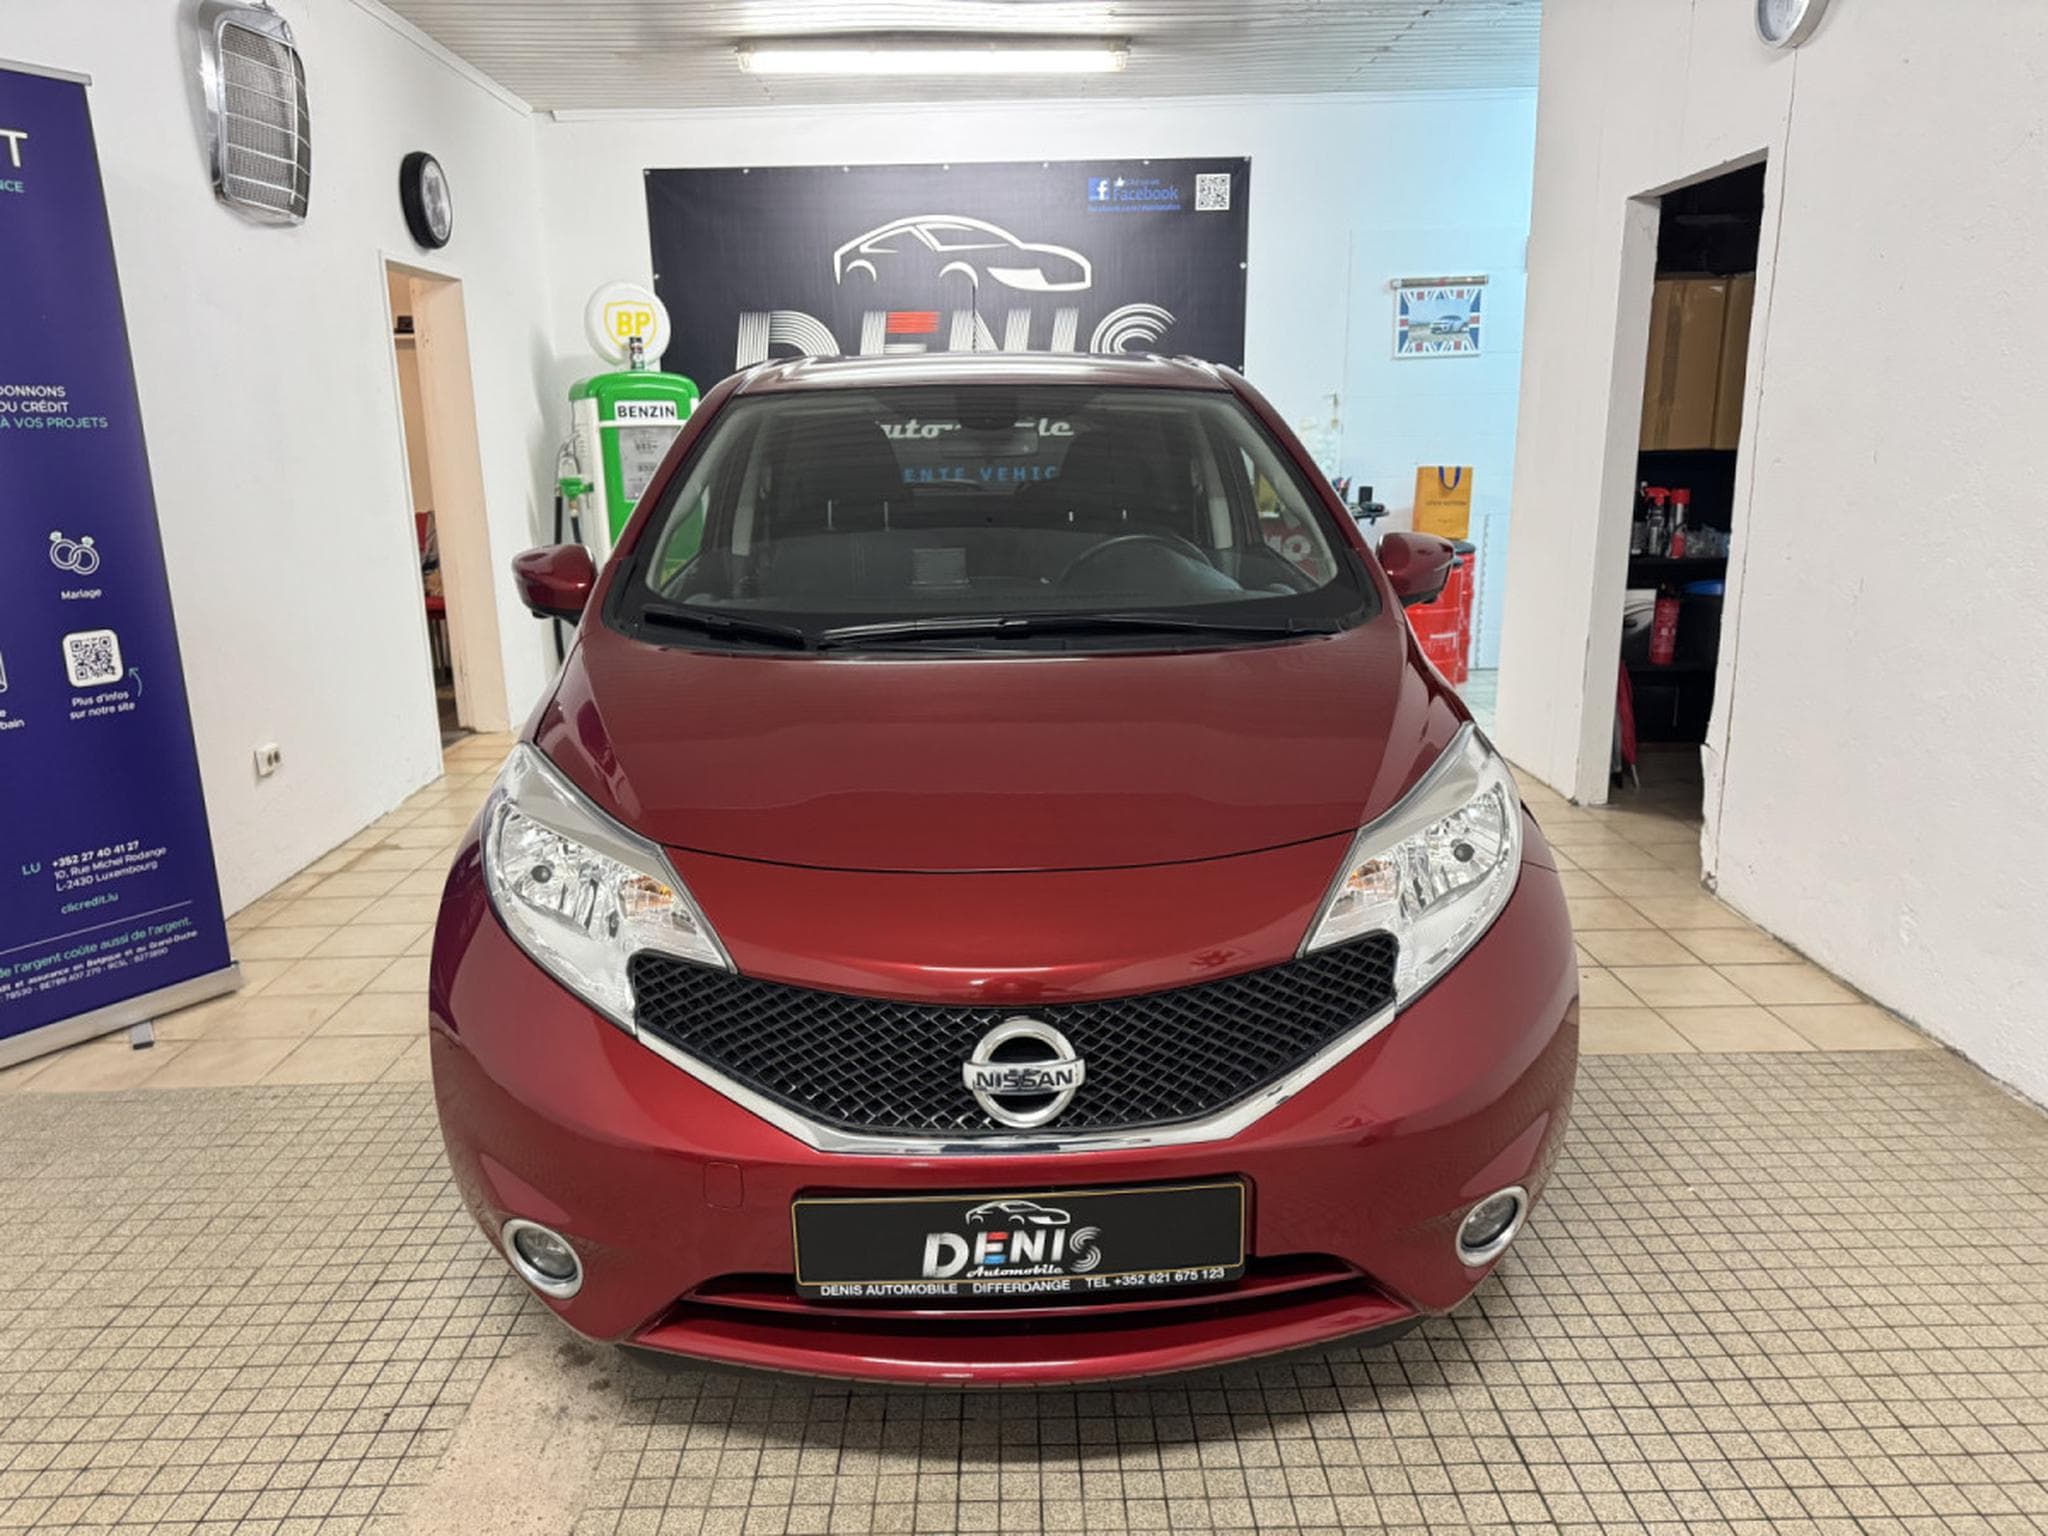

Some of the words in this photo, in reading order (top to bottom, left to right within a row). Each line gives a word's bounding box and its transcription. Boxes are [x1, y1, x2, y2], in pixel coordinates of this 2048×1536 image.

[1114, 184, 1180, 201] Facebook
[617, 310, 651, 337] BP
[21, 399, 69, 413] CRÉDIT
[617, 405, 675, 419] BENZIN
[13, 417, 44, 429] VOS
[47, 417, 108, 429] PROJETS
[903, 467, 966, 482] ENTE
[979, 465, 1058, 481] VEHIC
[61, 588, 102, 600] Mariage
[71, 697, 94, 707] Plus
[96, 691, 129, 703] d'infos
[70, 710, 86, 720] sur
[88, 705, 116, 717] notre
[118, 702, 135, 713] site
[52, 855, 79, 867] +352
[81, 851, 94, 862] 27
[97, 847, 112, 858] 40
[113, 844, 125, 854] 41
[127, 840, 139, 851] 27
[70, 866, 91, 877] Rue
[92, 857, 123, 871] Michel
[125, 847, 167, 864] Rodange
[22, 862, 41, 876] LU
[56, 875, 94, 892] L-2430
[96, 860, 158, 882] Luxembourg
[61, 893, 119, 914] clicredit.lu
[14, 952, 61, 974] l'argent
[100, 932, 129, 950] aussi
[131, 929, 146, 941] de
[976, 1069, 1073, 1089] NISSAN
[922, 1226, 1102, 1279] DENIS
[966, 1264, 1064, 1279] Automobile
[820, 1284, 863, 1296] DENIS
[866, 1283, 958, 1296] AUTOMOBILE
[972, 1279, 1071, 1294] DIFFERDANGE
[1085, 1276, 1111, 1289] TEL
[1114, 1273, 1145, 1287] +352
[1149, 1272, 1171, 1285] 621
[1174, 1269, 1198, 1282] 675
[1202, 1267, 1225, 1280] 123
